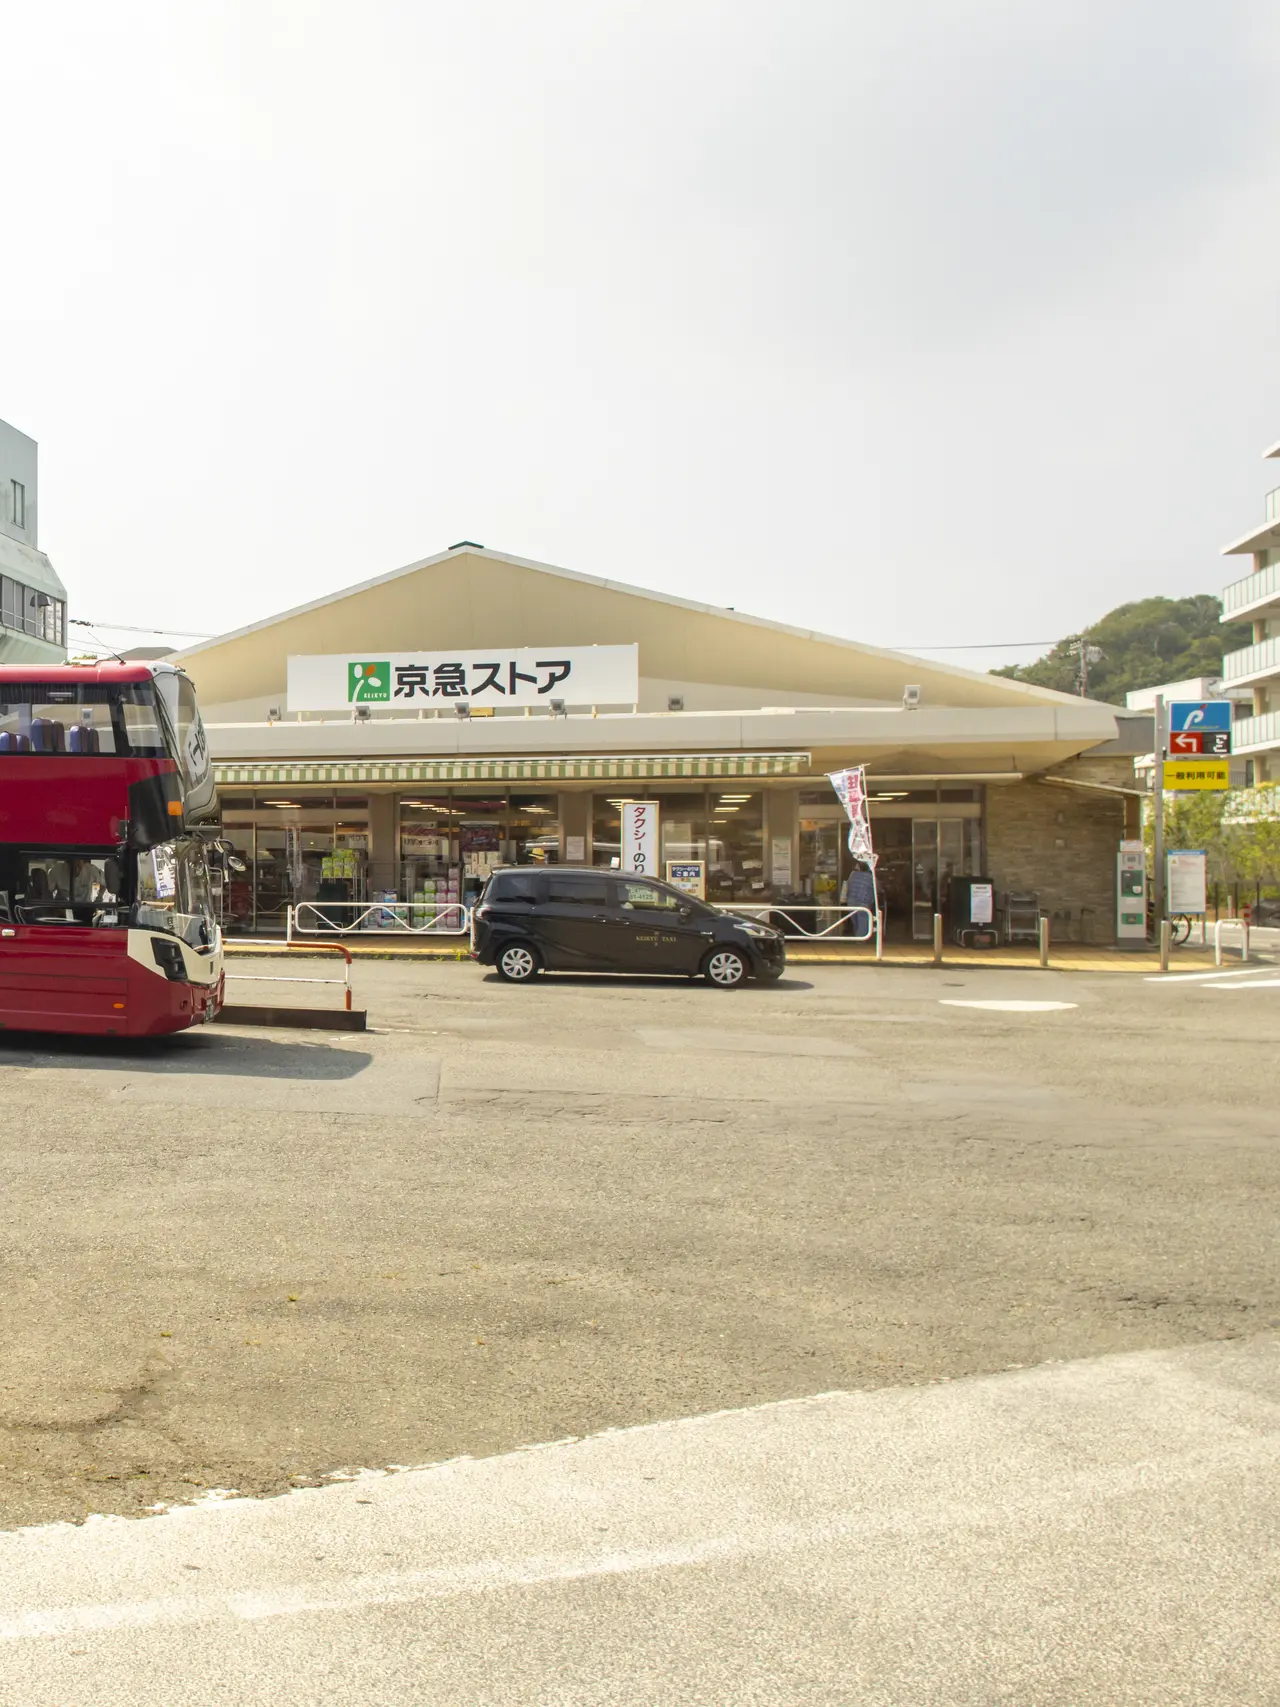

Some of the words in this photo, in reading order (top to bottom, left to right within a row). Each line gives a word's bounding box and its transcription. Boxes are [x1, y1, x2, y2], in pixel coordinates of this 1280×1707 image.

[394, 660, 571, 698] 京急ストア
[1165, 771, 1226, 780] 一般利用可能
